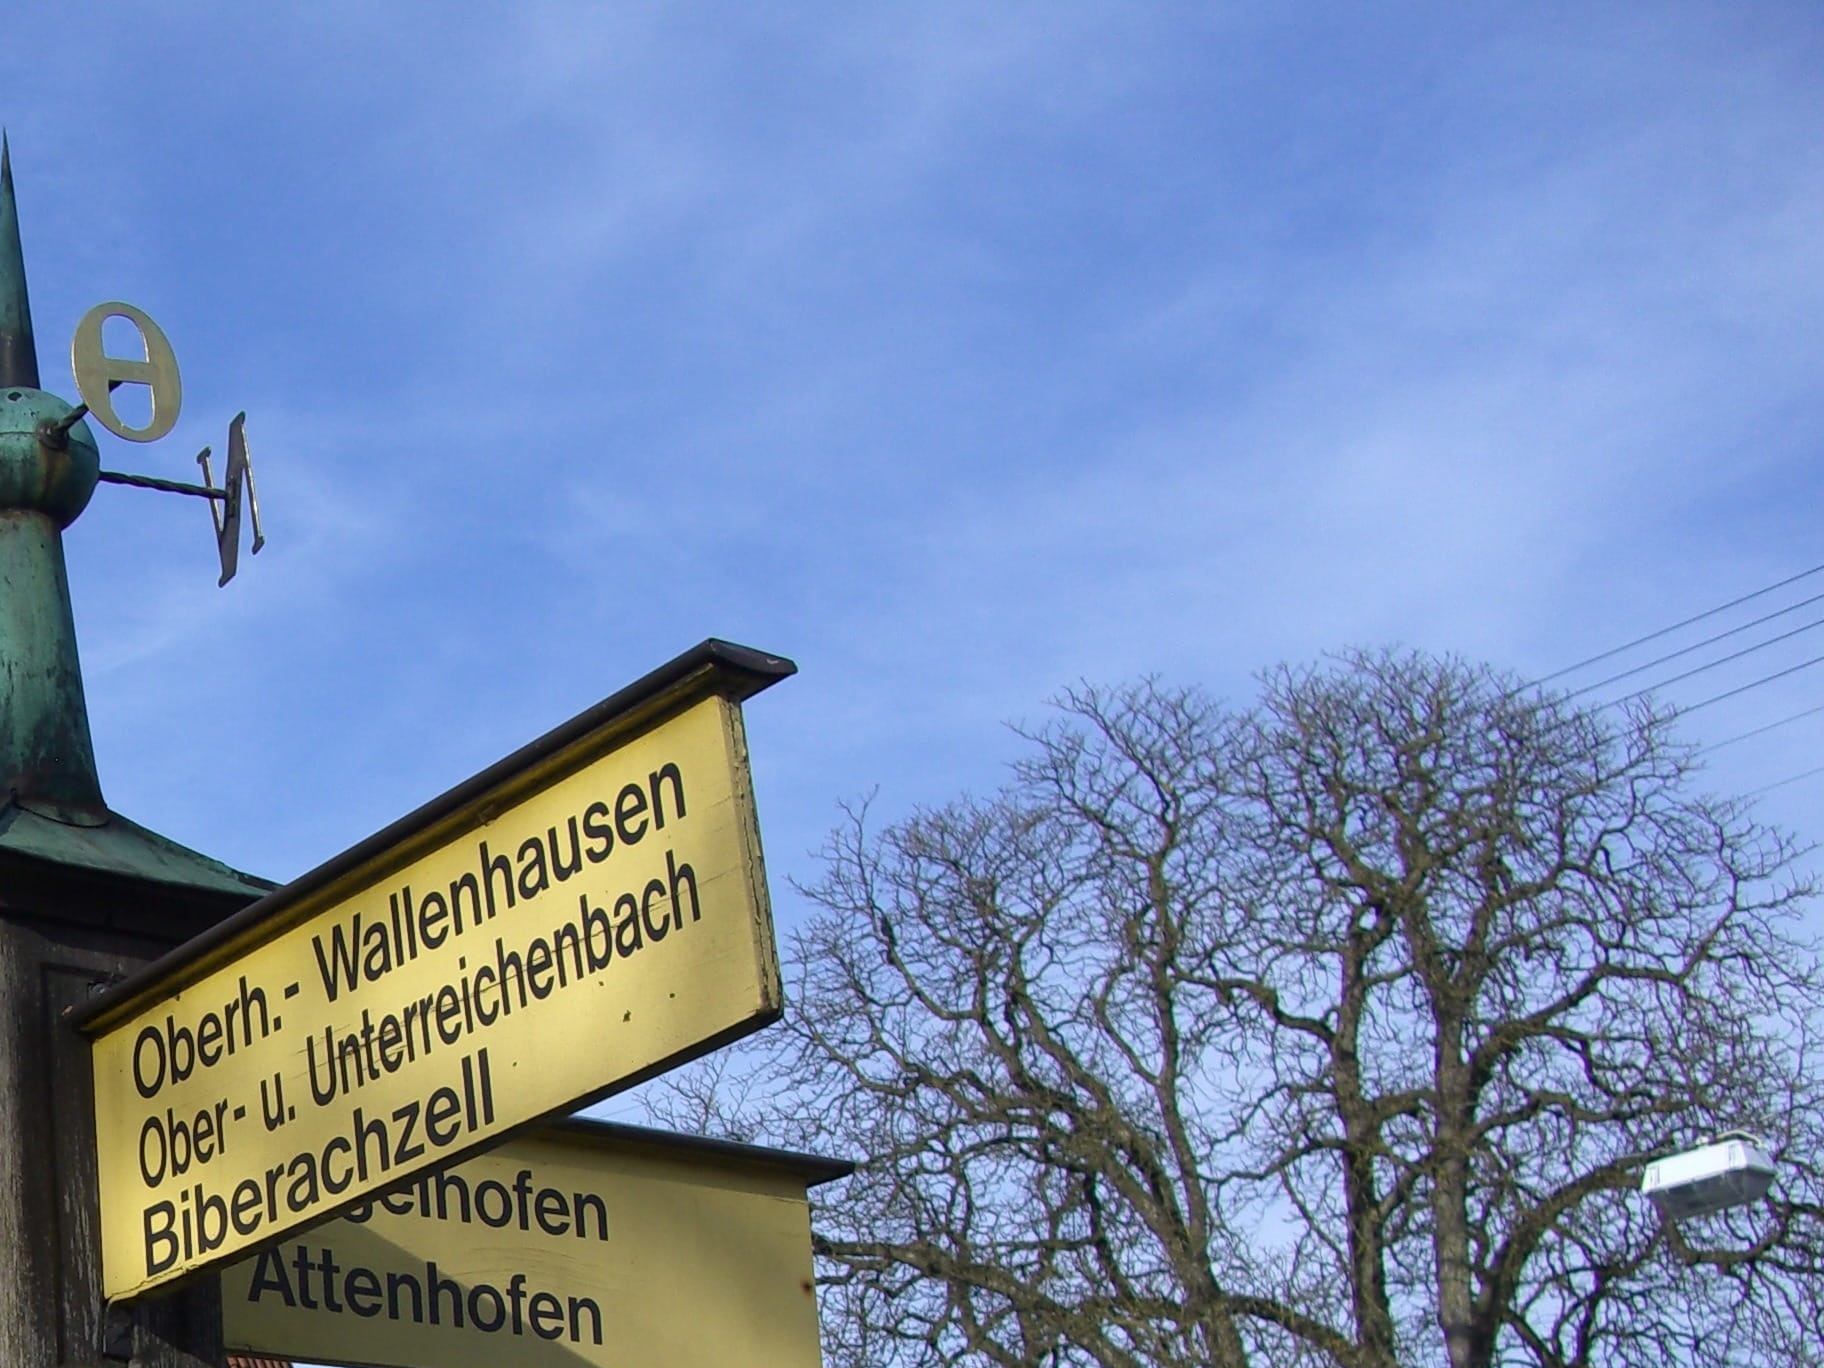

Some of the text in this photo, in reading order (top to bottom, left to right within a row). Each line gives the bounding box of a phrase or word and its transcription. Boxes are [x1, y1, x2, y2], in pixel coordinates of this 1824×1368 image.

[312, 761, 686, 1002] Wallenhausen
[139, 849, 701, 1189] Ober- u. Unterreichenbach
[143, 1047, 494, 1278] Biberachzell
[248, 1244, 603, 1346] Attenhofen
